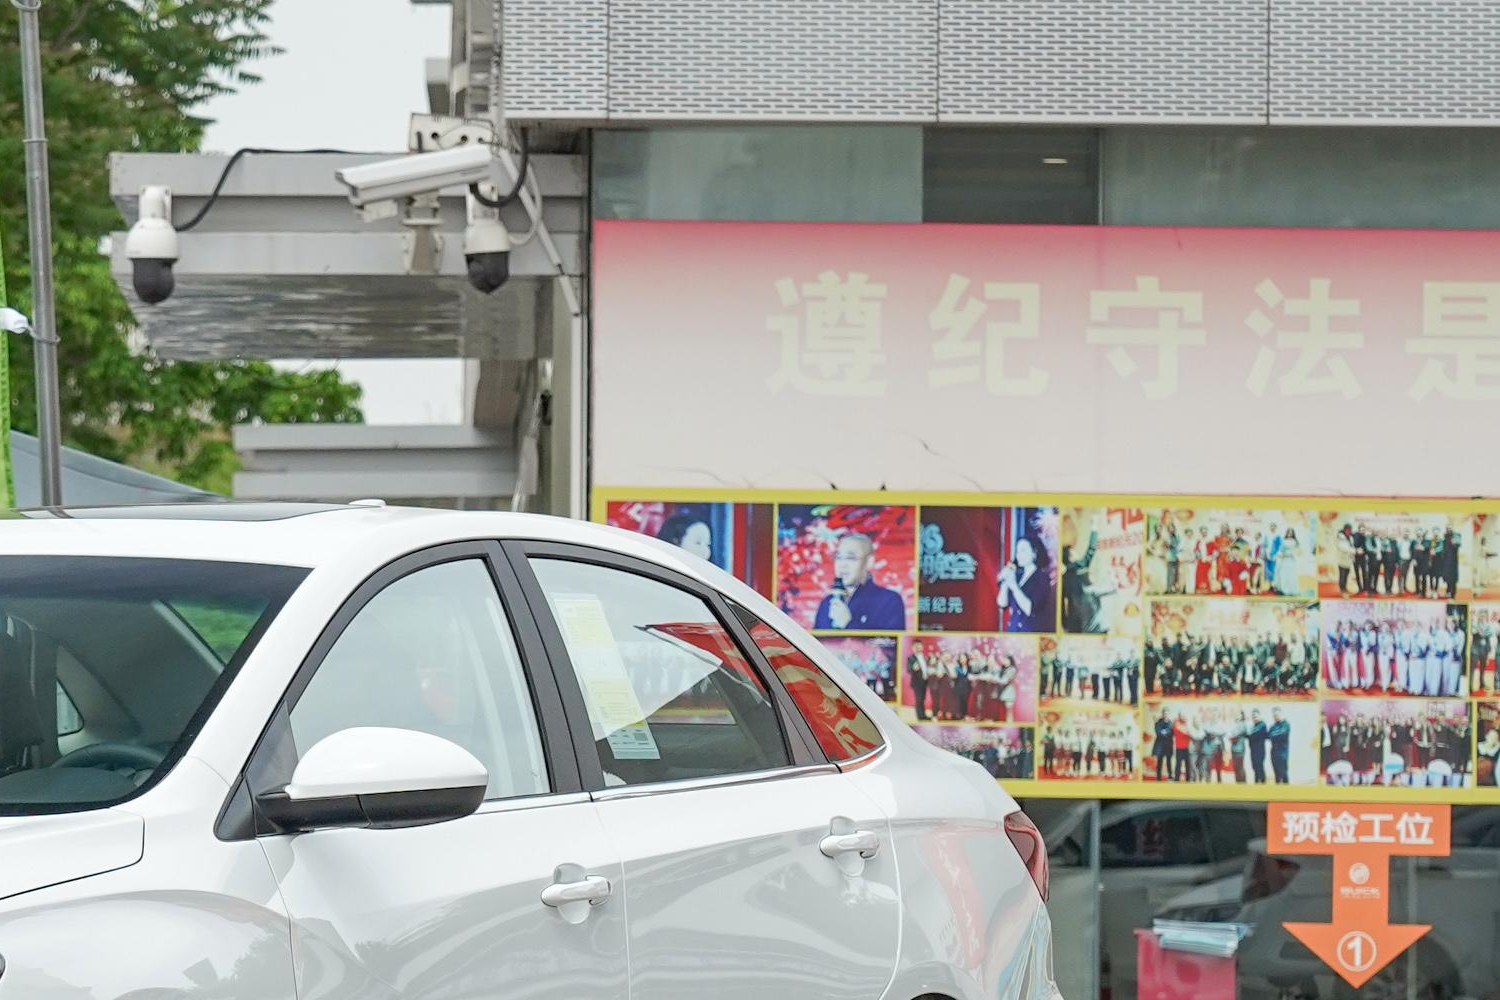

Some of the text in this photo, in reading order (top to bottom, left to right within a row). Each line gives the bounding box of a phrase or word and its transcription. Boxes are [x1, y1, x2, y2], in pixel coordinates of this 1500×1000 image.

[765, 269, 1500, 402] 遵纪守法是
[1282, 810, 1435, 845] 预检工位
